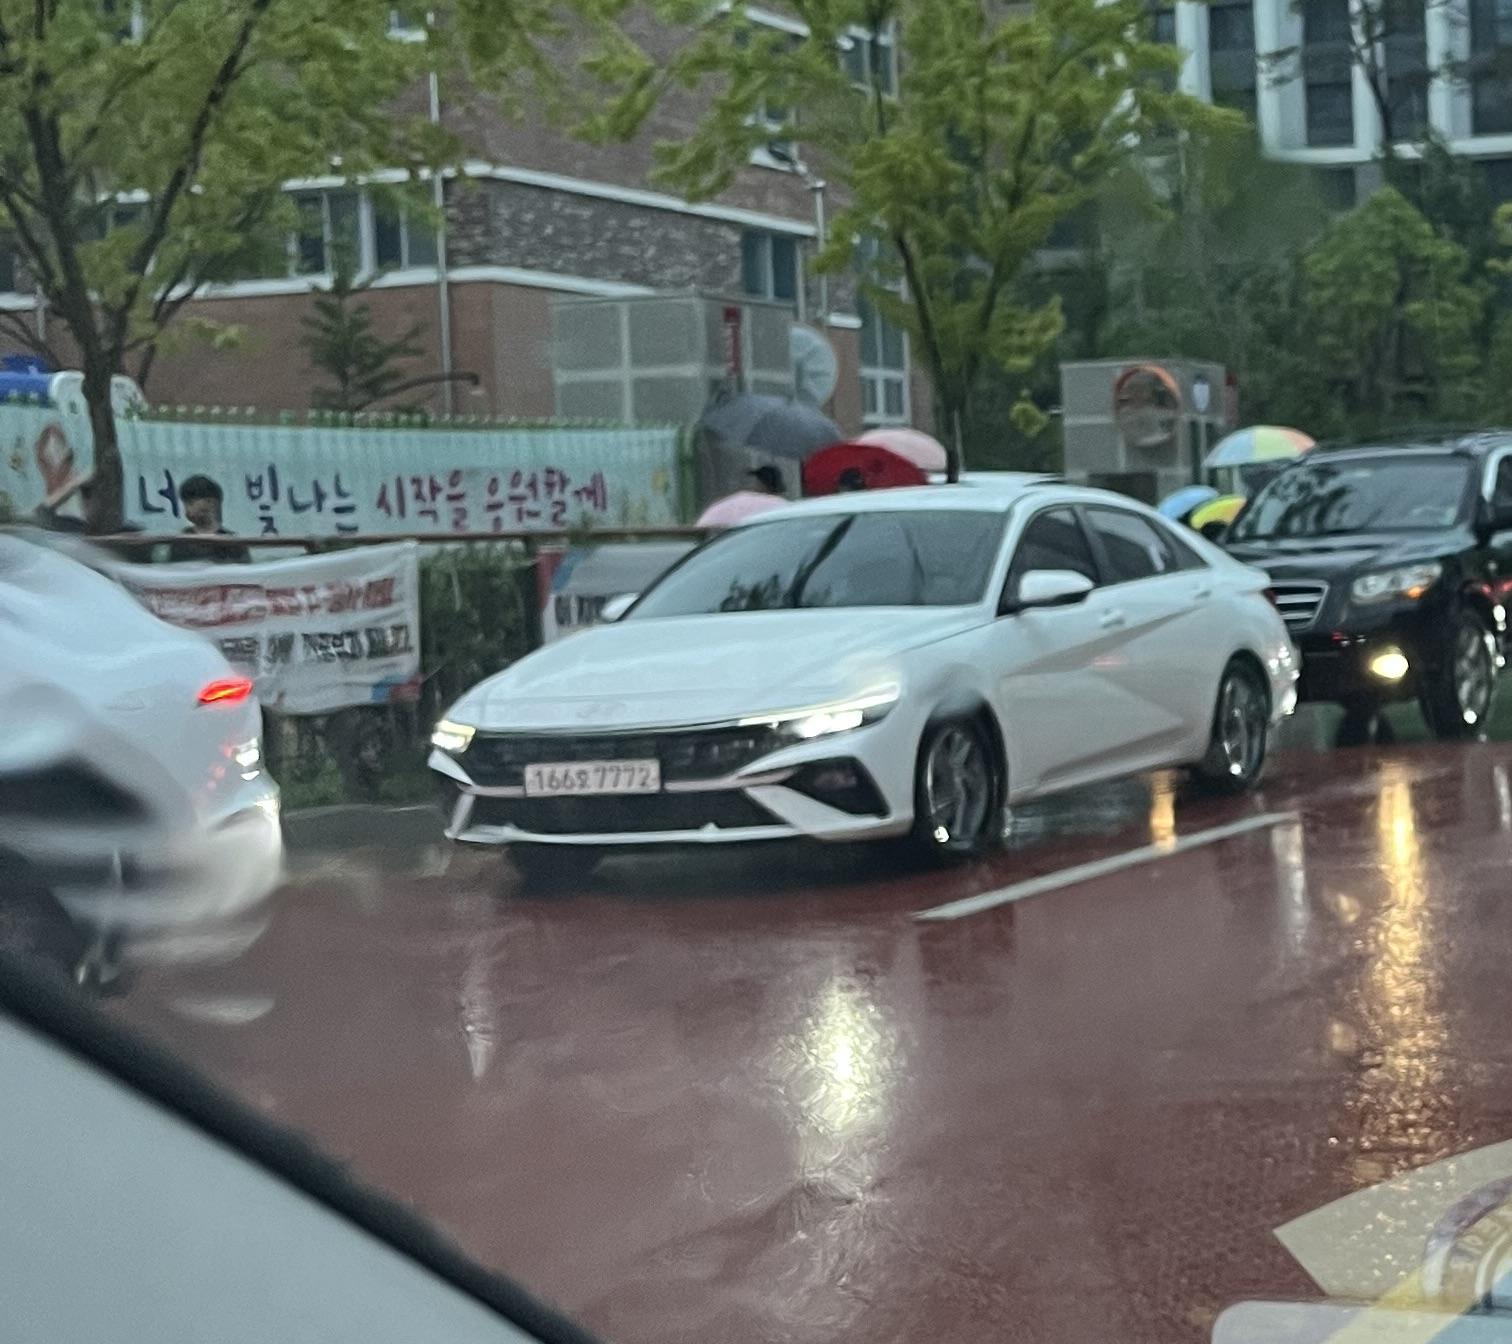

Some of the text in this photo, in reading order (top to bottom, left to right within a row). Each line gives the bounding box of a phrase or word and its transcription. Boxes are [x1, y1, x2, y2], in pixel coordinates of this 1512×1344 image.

[245, 463, 360, 537] 빛나는
[377, 468, 468, 532] 시작을
[486, 465, 607, 533] 응원할게
